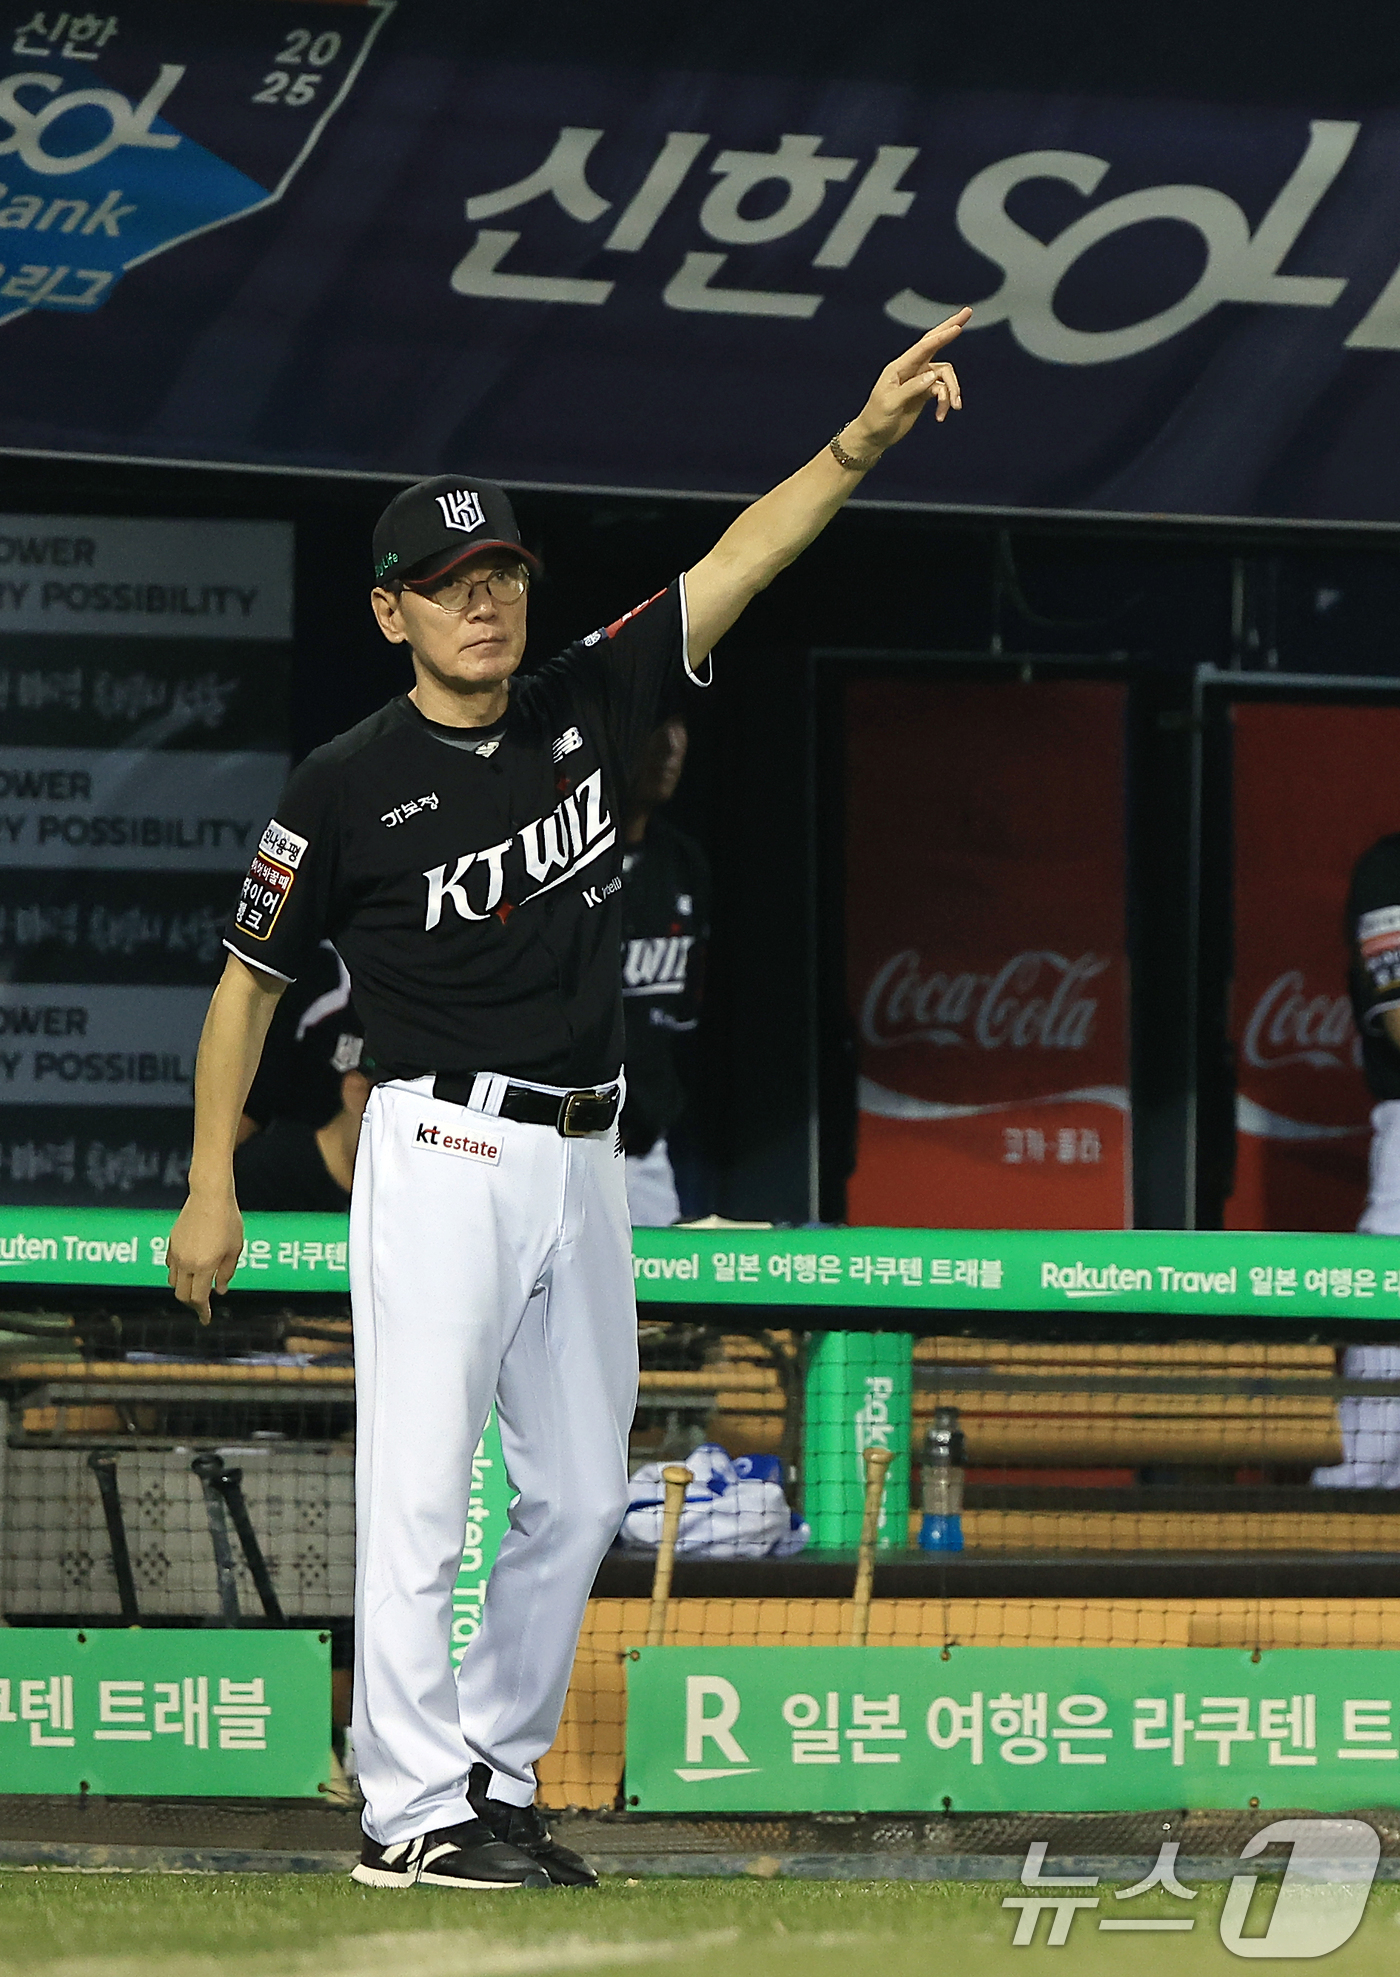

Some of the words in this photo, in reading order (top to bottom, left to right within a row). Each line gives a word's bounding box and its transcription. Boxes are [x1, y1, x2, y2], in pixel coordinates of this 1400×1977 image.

[12, 11, 118, 61] 신한
[274, 29, 342, 67] 20
[252, 70, 322, 106] 25
[0, 183, 137, 238] ank
[450, 126, 920, 318] 신한
[0, 264, 113, 305] 리그
[0, 581, 30, 611] Y
[42, 582, 258, 616] POSSIBILITY
[38, 814, 250, 847] POSSIBILITY
[422, 837, 513, 932] KT
[517, 767, 612, 884] WIZ
[34, 1051, 191, 1083] POSSIBIL
[415, 1122, 441, 1146] kt
[442, 1135, 498, 1159] estate
[0, 1233, 58, 1265] uten
[62, 1235, 138, 1263] Travel
[150, 1236, 170, 1267] 일
[278, 1241, 347, 1271] 라쿠텐
[711, 1252, 761, 1283] 일본
[768, 1253, 843, 1285] 여행은
[848, 1255, 923, 1287] 라쿠텐
[929, 1258, 1004, 1290] 트래블
[1041, 1261, 1152, 1298] Rakuten
[1157, 1265, 1237, 1294] Travel
[1249, 1266, 1298, 1297] 일본
[1304, 1267, 1376, 1298] 여행은
[452, 1579, 487, 1685] Trav
[93, 1675, 272, 1750] 트래블
[782, 1691, 907, 1765] 일본
[926, 1691, 1113, 1766] 여행은
[1132, 1693, 1318, 1767] 라쿠텐
